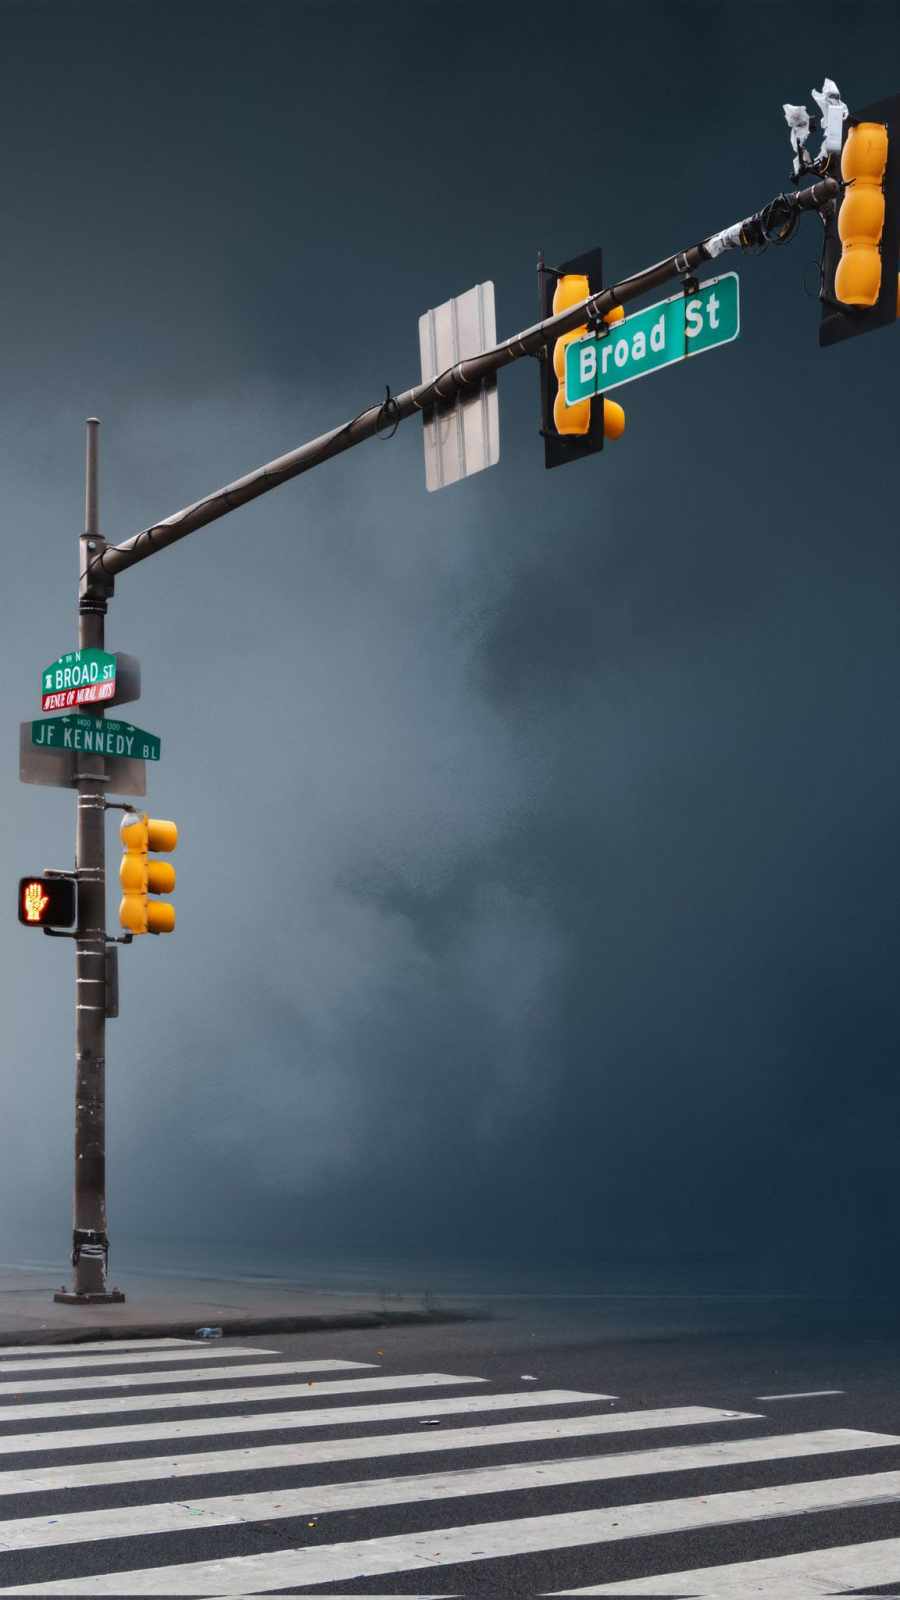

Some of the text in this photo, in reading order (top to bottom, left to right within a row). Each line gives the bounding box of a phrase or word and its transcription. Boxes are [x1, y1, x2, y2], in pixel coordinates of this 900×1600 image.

[579, 292, 720, 384] Broad St
[55, 662, 113, 690] BROAD ST
[66, 690, 76, 705] OF
[96, 719, 103, 729] W
[36, 724, 158, 759] JF KENNEDY BL
